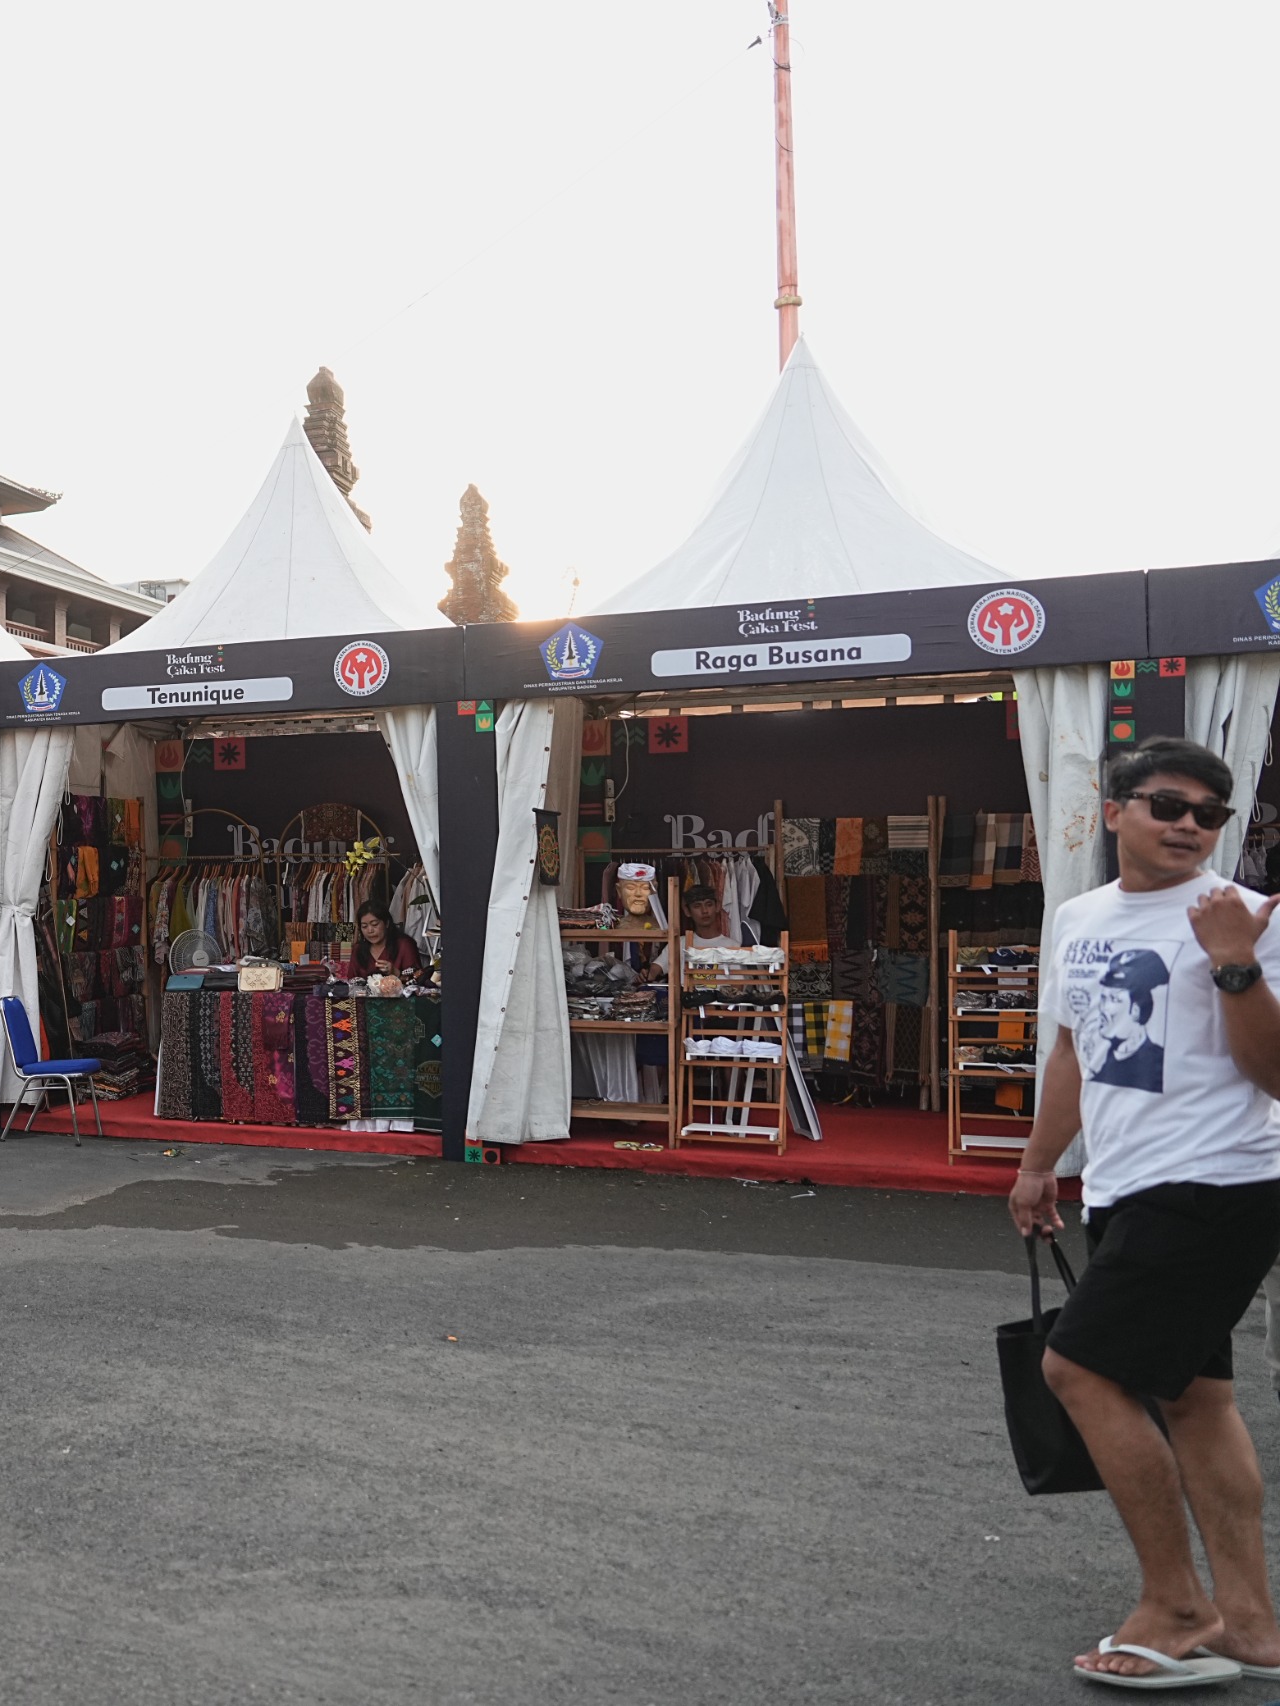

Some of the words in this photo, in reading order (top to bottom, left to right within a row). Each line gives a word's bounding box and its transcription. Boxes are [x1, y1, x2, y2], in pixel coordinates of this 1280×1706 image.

[737, 608, 802, 623] Badung
[974, 591, 1005, 612] KERAJINAN
[1006, 590, 1036, 606] NASIONAL
[1034, 605, 1042, 629] DAERAH
[738, 621, 779, 637] Çaka
[782, 618, 819, 633] Fest
[976, 638, 1012, 654] KABUPATEN
[1013, 634, 1037, 652] BADUNG
[166, 653, 214, 665] Badung
[695, 648, 758, 672] Raga
[769, 644, 862, 665] Busana
[199, 663, 226, 674] Fest
[146, 684, 245, 706] Tenunique
